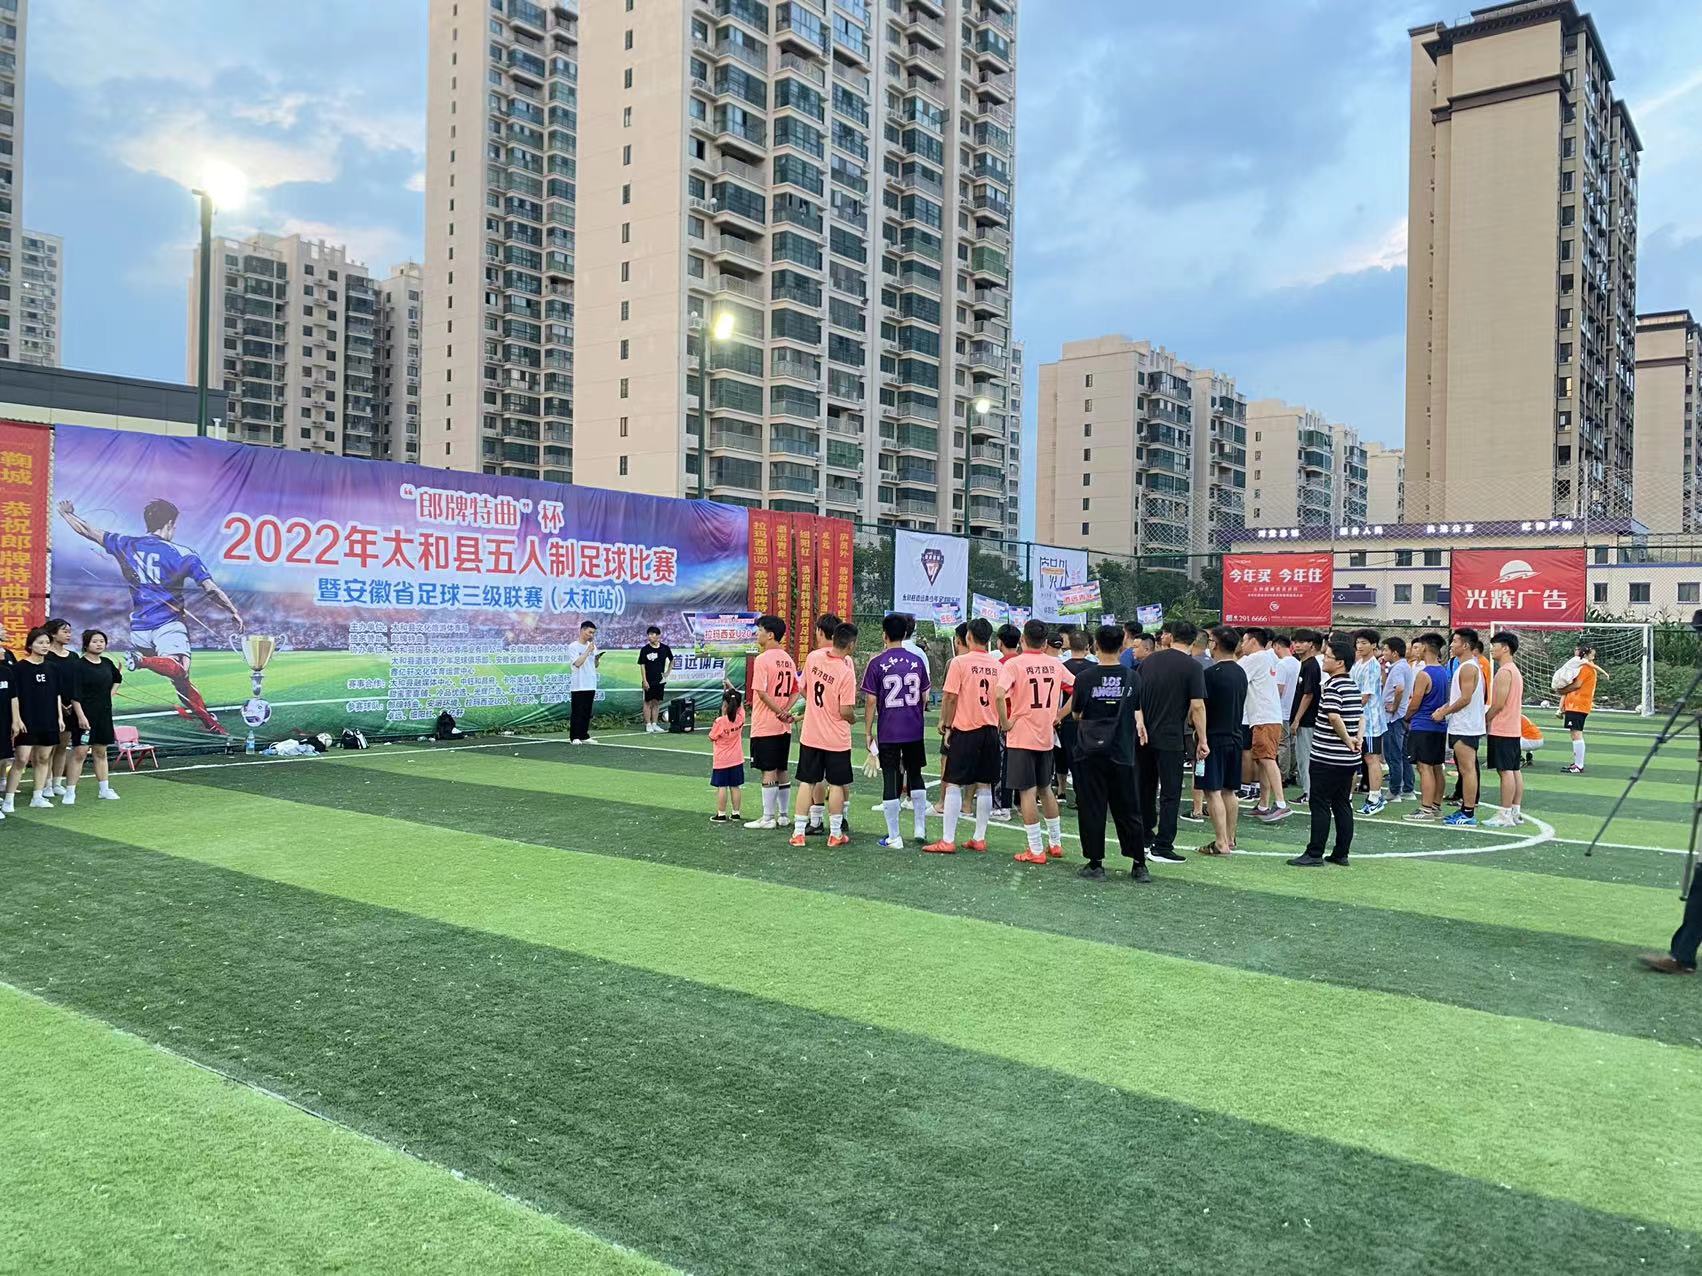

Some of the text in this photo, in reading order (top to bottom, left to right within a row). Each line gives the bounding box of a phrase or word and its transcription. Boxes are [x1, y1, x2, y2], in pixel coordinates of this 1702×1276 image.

[223, 517, 676, 582] 2022年太和县五人制足球比赛
[1229, 568, 1323, 583] 今年买 今年住
[1465, 589, 1568, 610] 光辉广告
[814, 681, 825, 707] 8
[883, 672, 921, 708] 23
[979, 678, 990, 707] 3
[1029, 677, 1055, 709] 17
[1102, 676, 1122, 687] LOS
